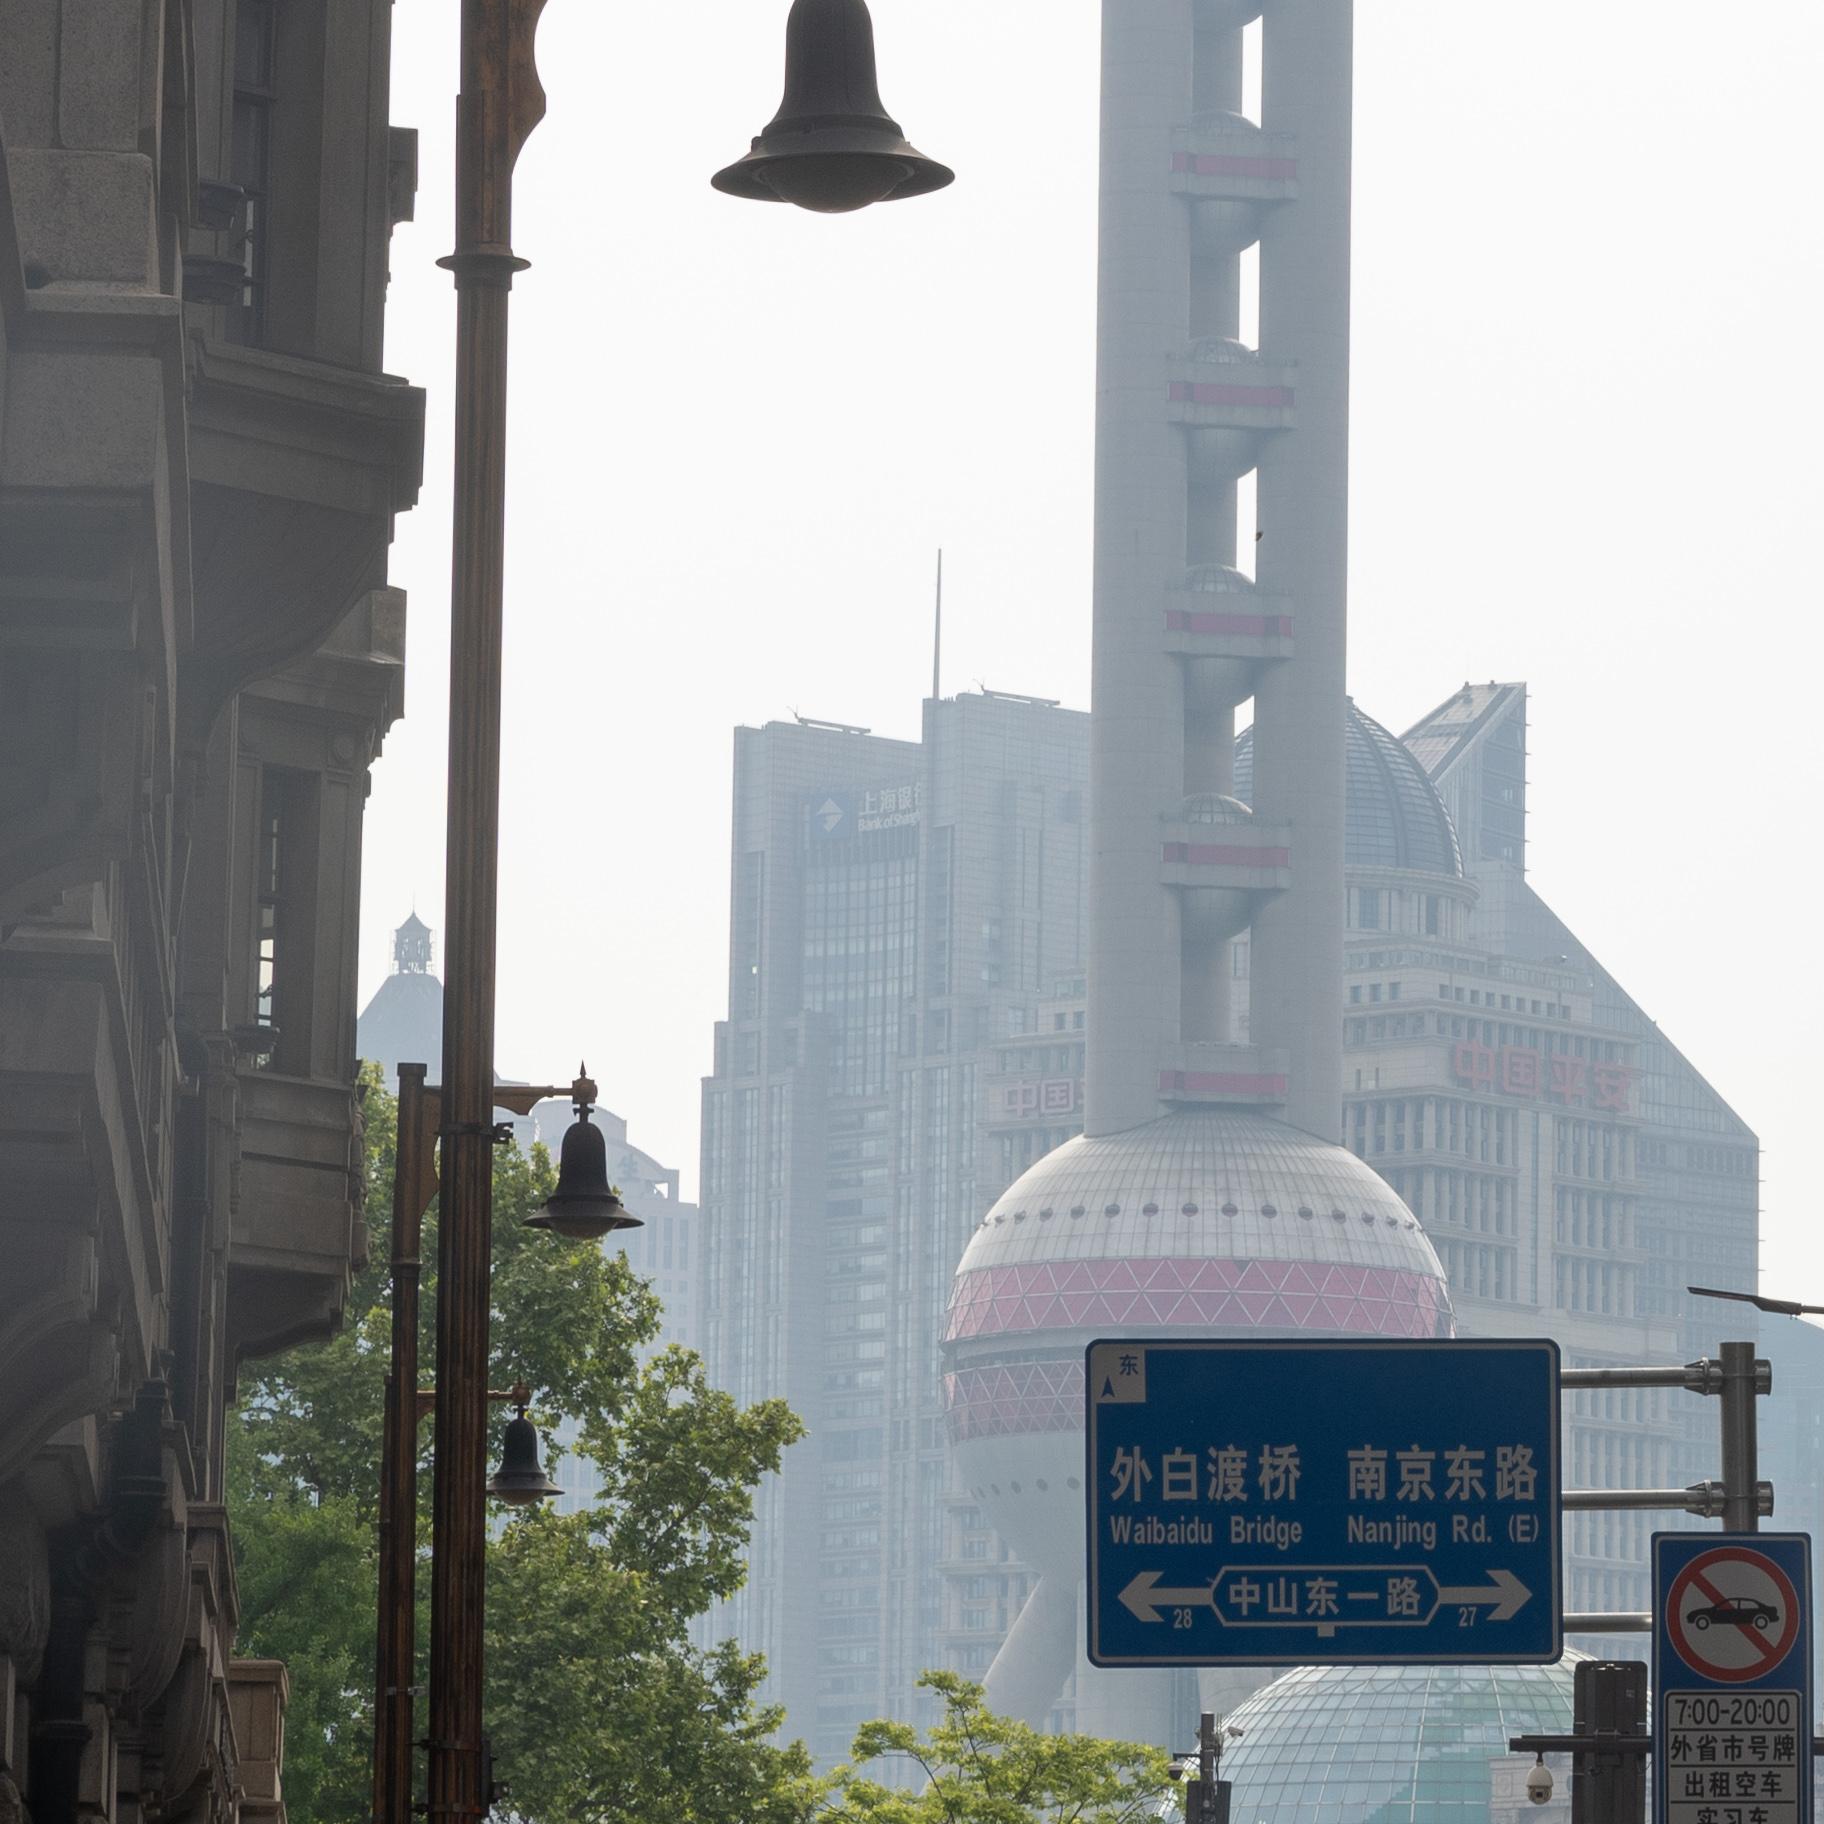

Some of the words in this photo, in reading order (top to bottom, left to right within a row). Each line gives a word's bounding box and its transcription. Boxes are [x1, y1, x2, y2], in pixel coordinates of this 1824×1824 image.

[1456, 1040, 1632, 1112] 中国平安
[1004, 1078, 1085, 1118] 中国
[1119, 1354, 1139, 1375] 东
[1110, 1444, 1302, 1501] 外白渡桥
[1346, 1444, 1538, 1501] 南京东路
[1110, 1515, 1213, 1544] Waibaidu
[1230, 1514, 1303, 1550] Bridge
[1346, 1514, 1437, 1550] Nanjing
[1452, 1514, 1492, 1543] Rd.
[1508, 1514, 1539, 1543] (E)
[1228, 1577, 1421, 1616] 中山东一路
[1173, 1608, 1193, 1629] 28
[1458, 1606, 1477, 1627] 27
[1675, 1698, 1790, 1725] 7:00-20:00
[1671, 1735, 1795, 1762] 外省市号牌
[1685, 1772, 1782, 1798] 出租空车
